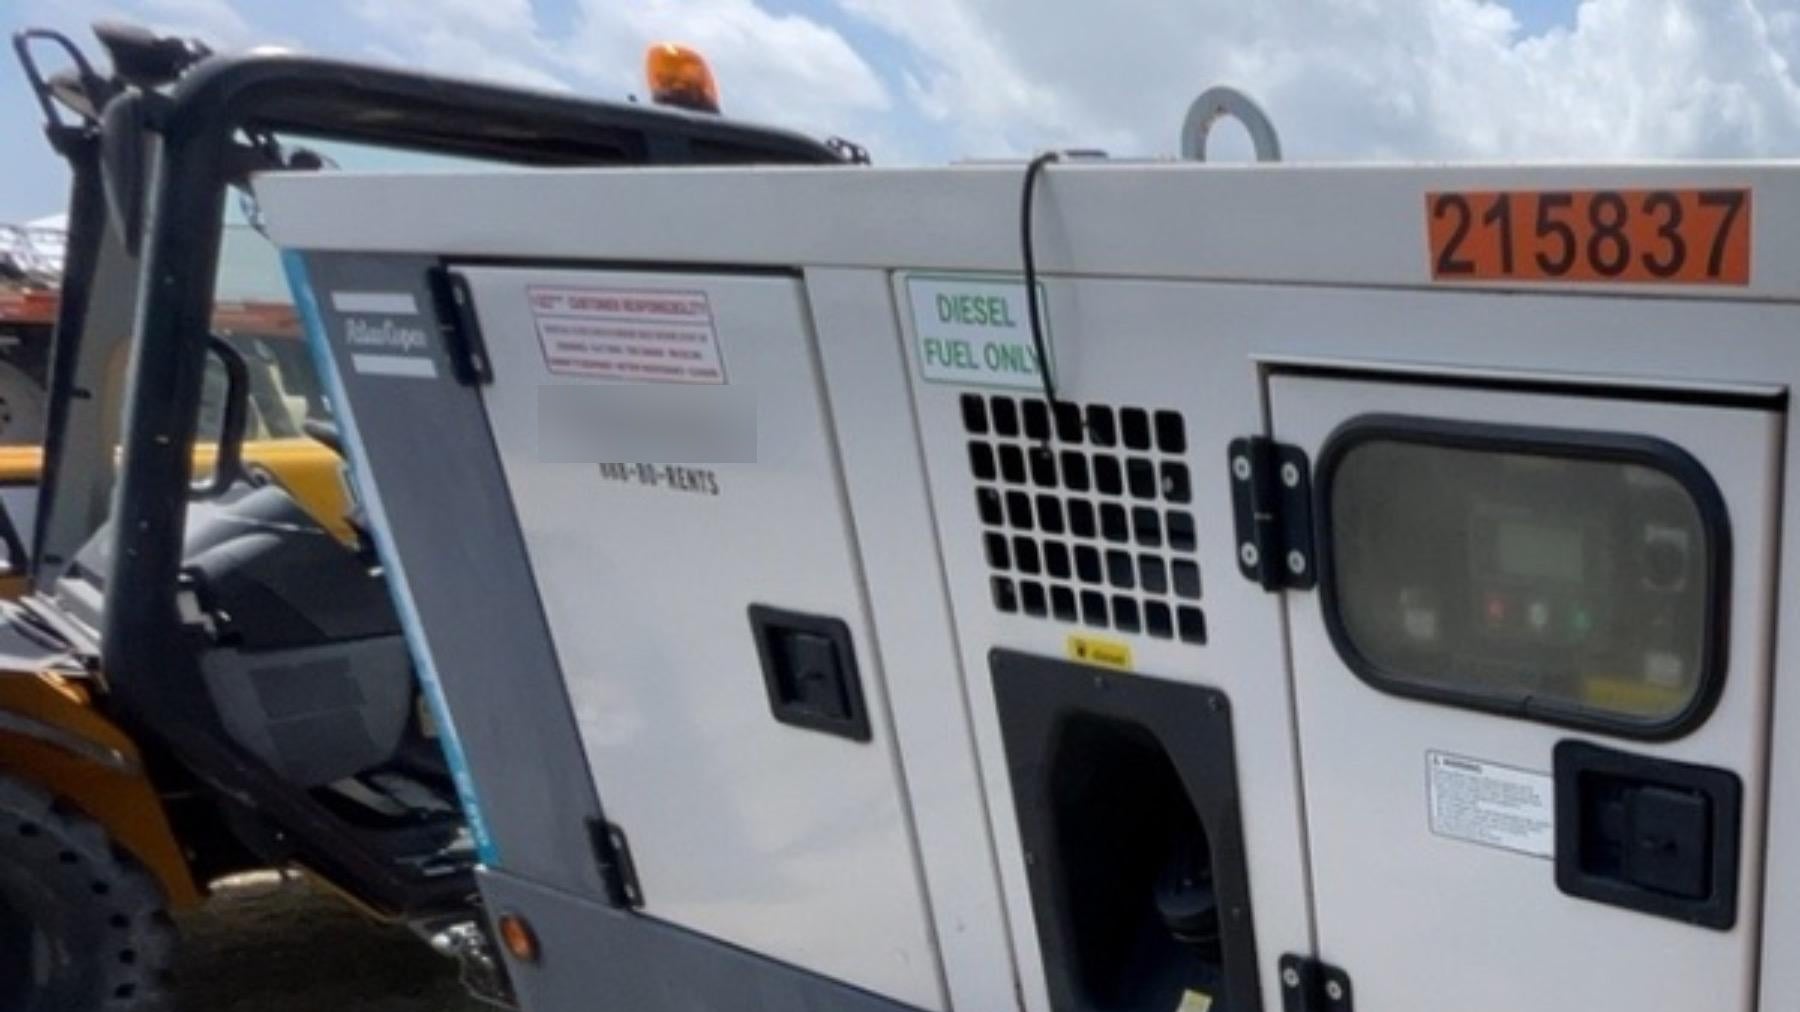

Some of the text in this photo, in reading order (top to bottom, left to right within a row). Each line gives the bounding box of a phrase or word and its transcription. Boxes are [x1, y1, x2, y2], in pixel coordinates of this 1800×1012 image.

[1433, 192, 1745, 277] 215837
[936, 293, 1017, 328] DIESEL
[924, 337, 979, 370] FUEL
